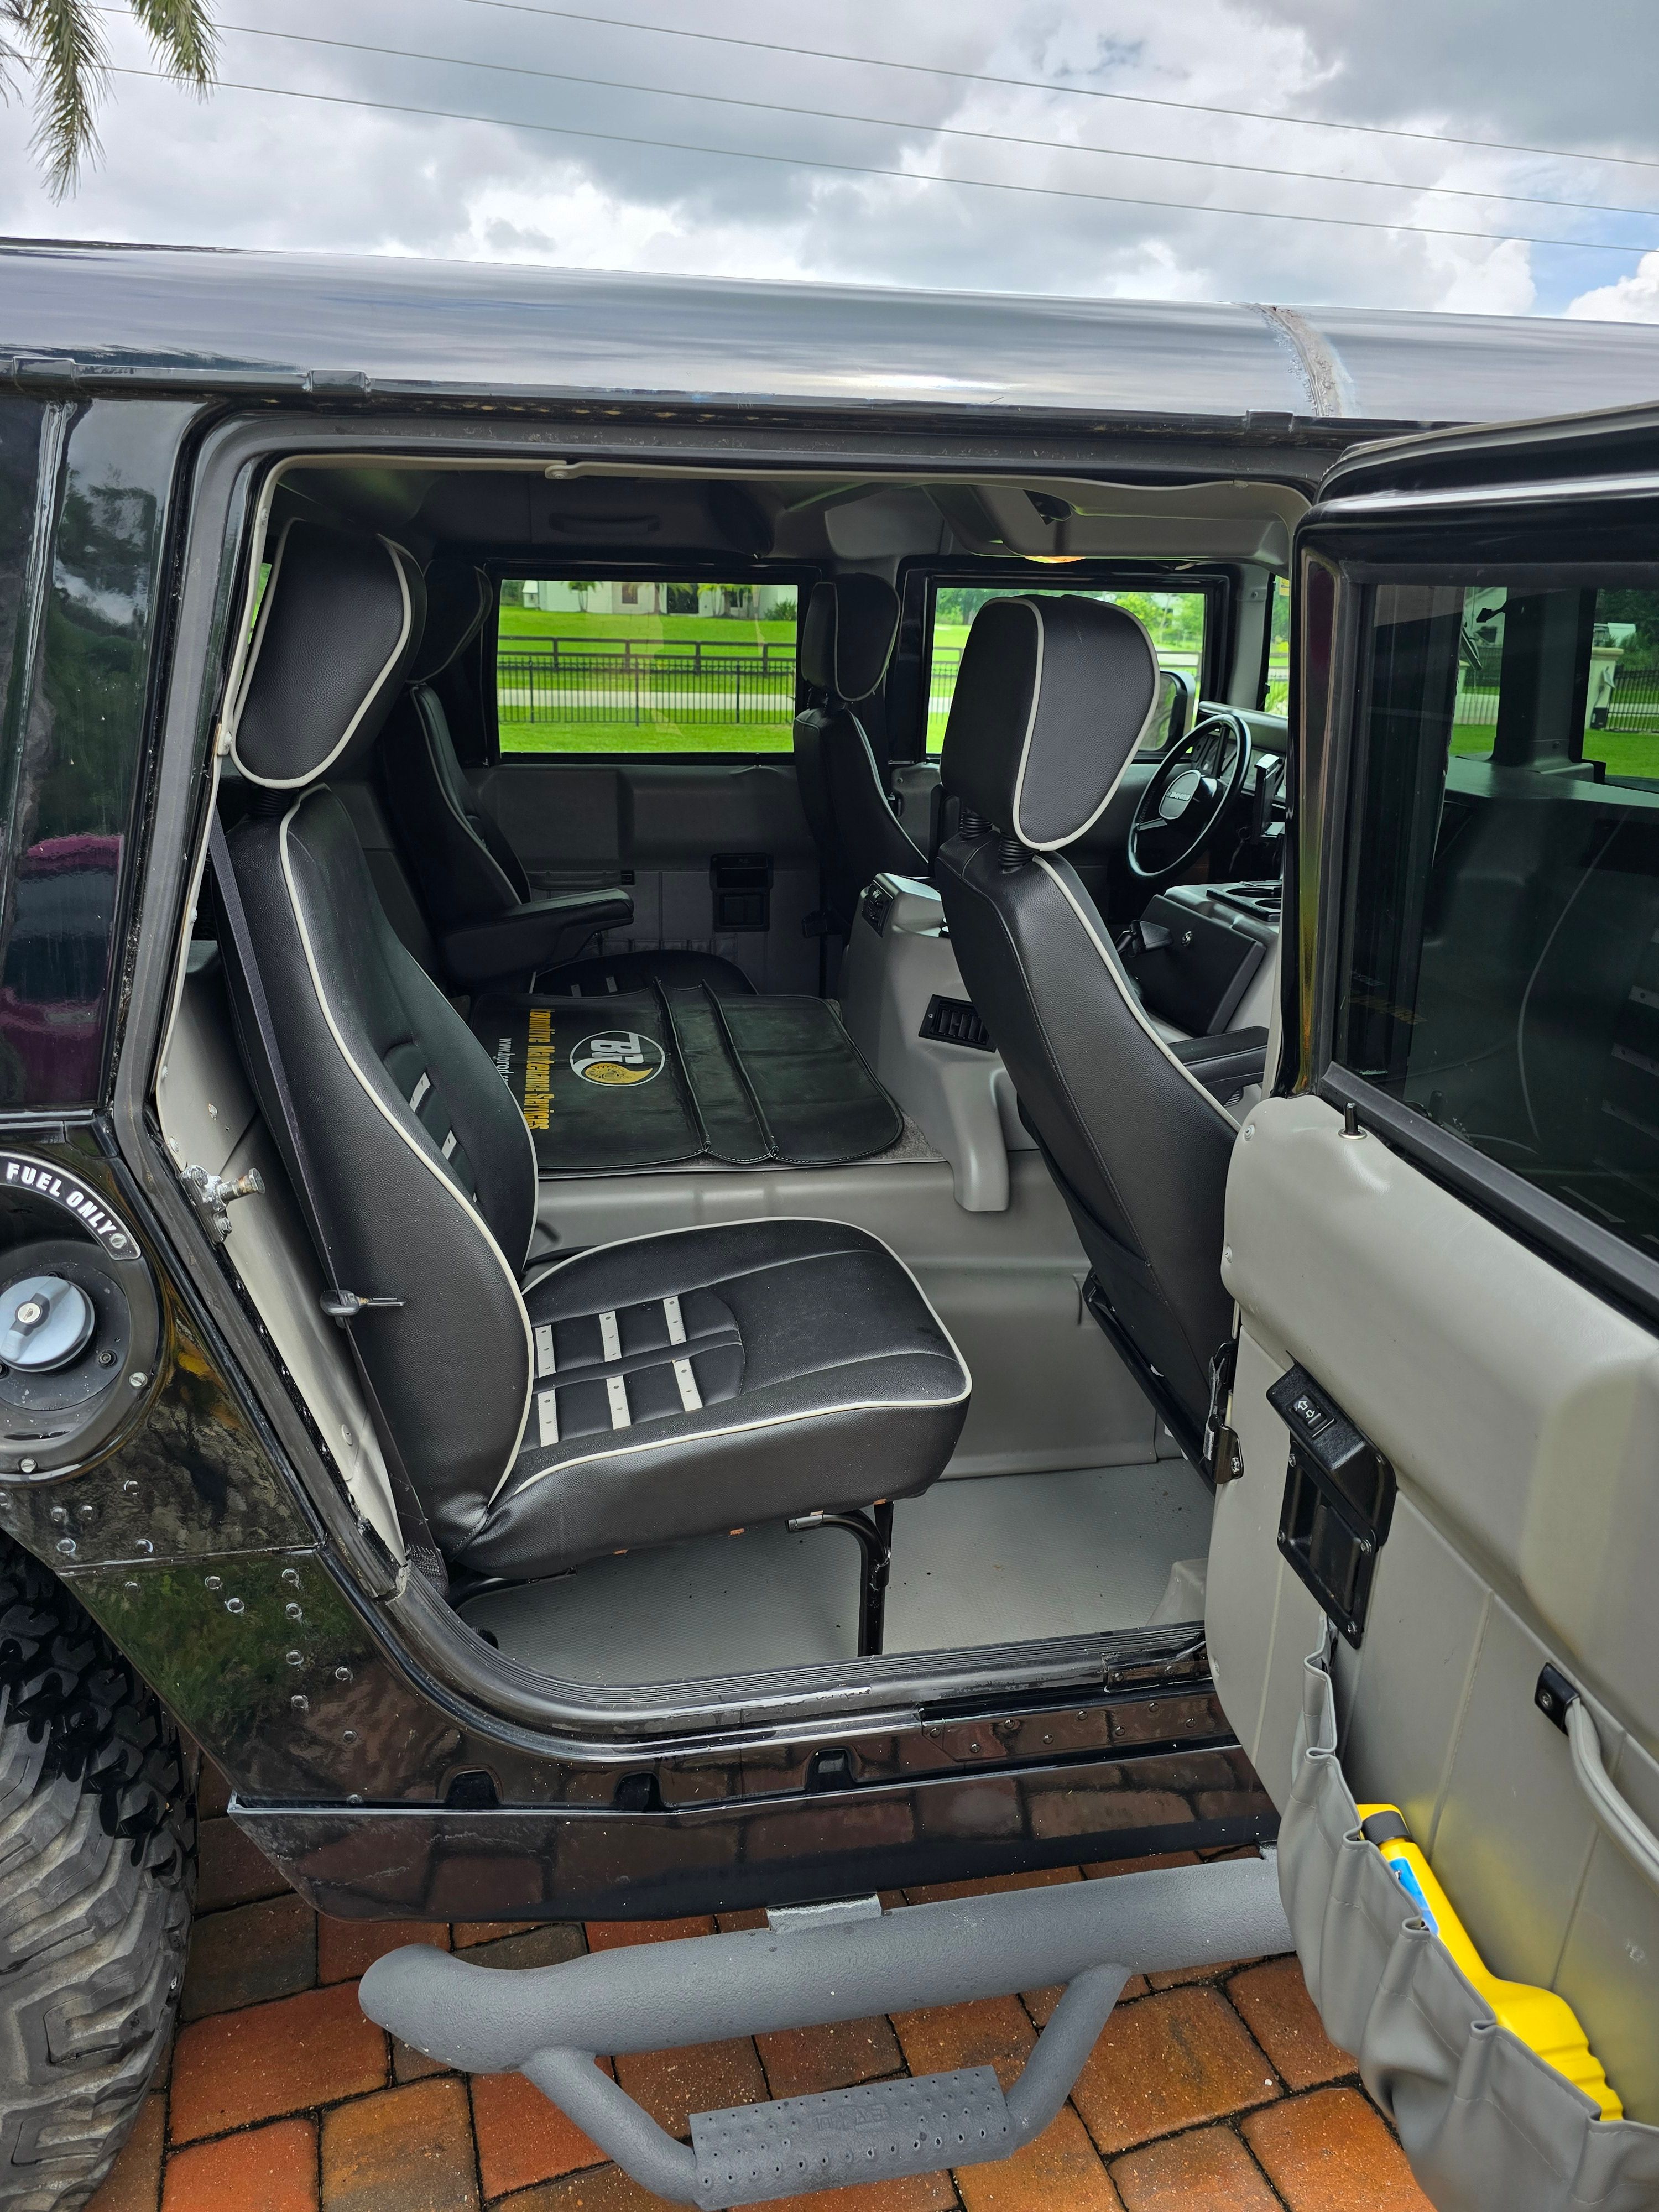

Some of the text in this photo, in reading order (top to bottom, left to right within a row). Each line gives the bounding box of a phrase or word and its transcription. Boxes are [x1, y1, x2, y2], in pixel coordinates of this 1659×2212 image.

[524, 1093, 555, 1129] Services
[6, 1162, 117, 1235] FUEL ONLY
